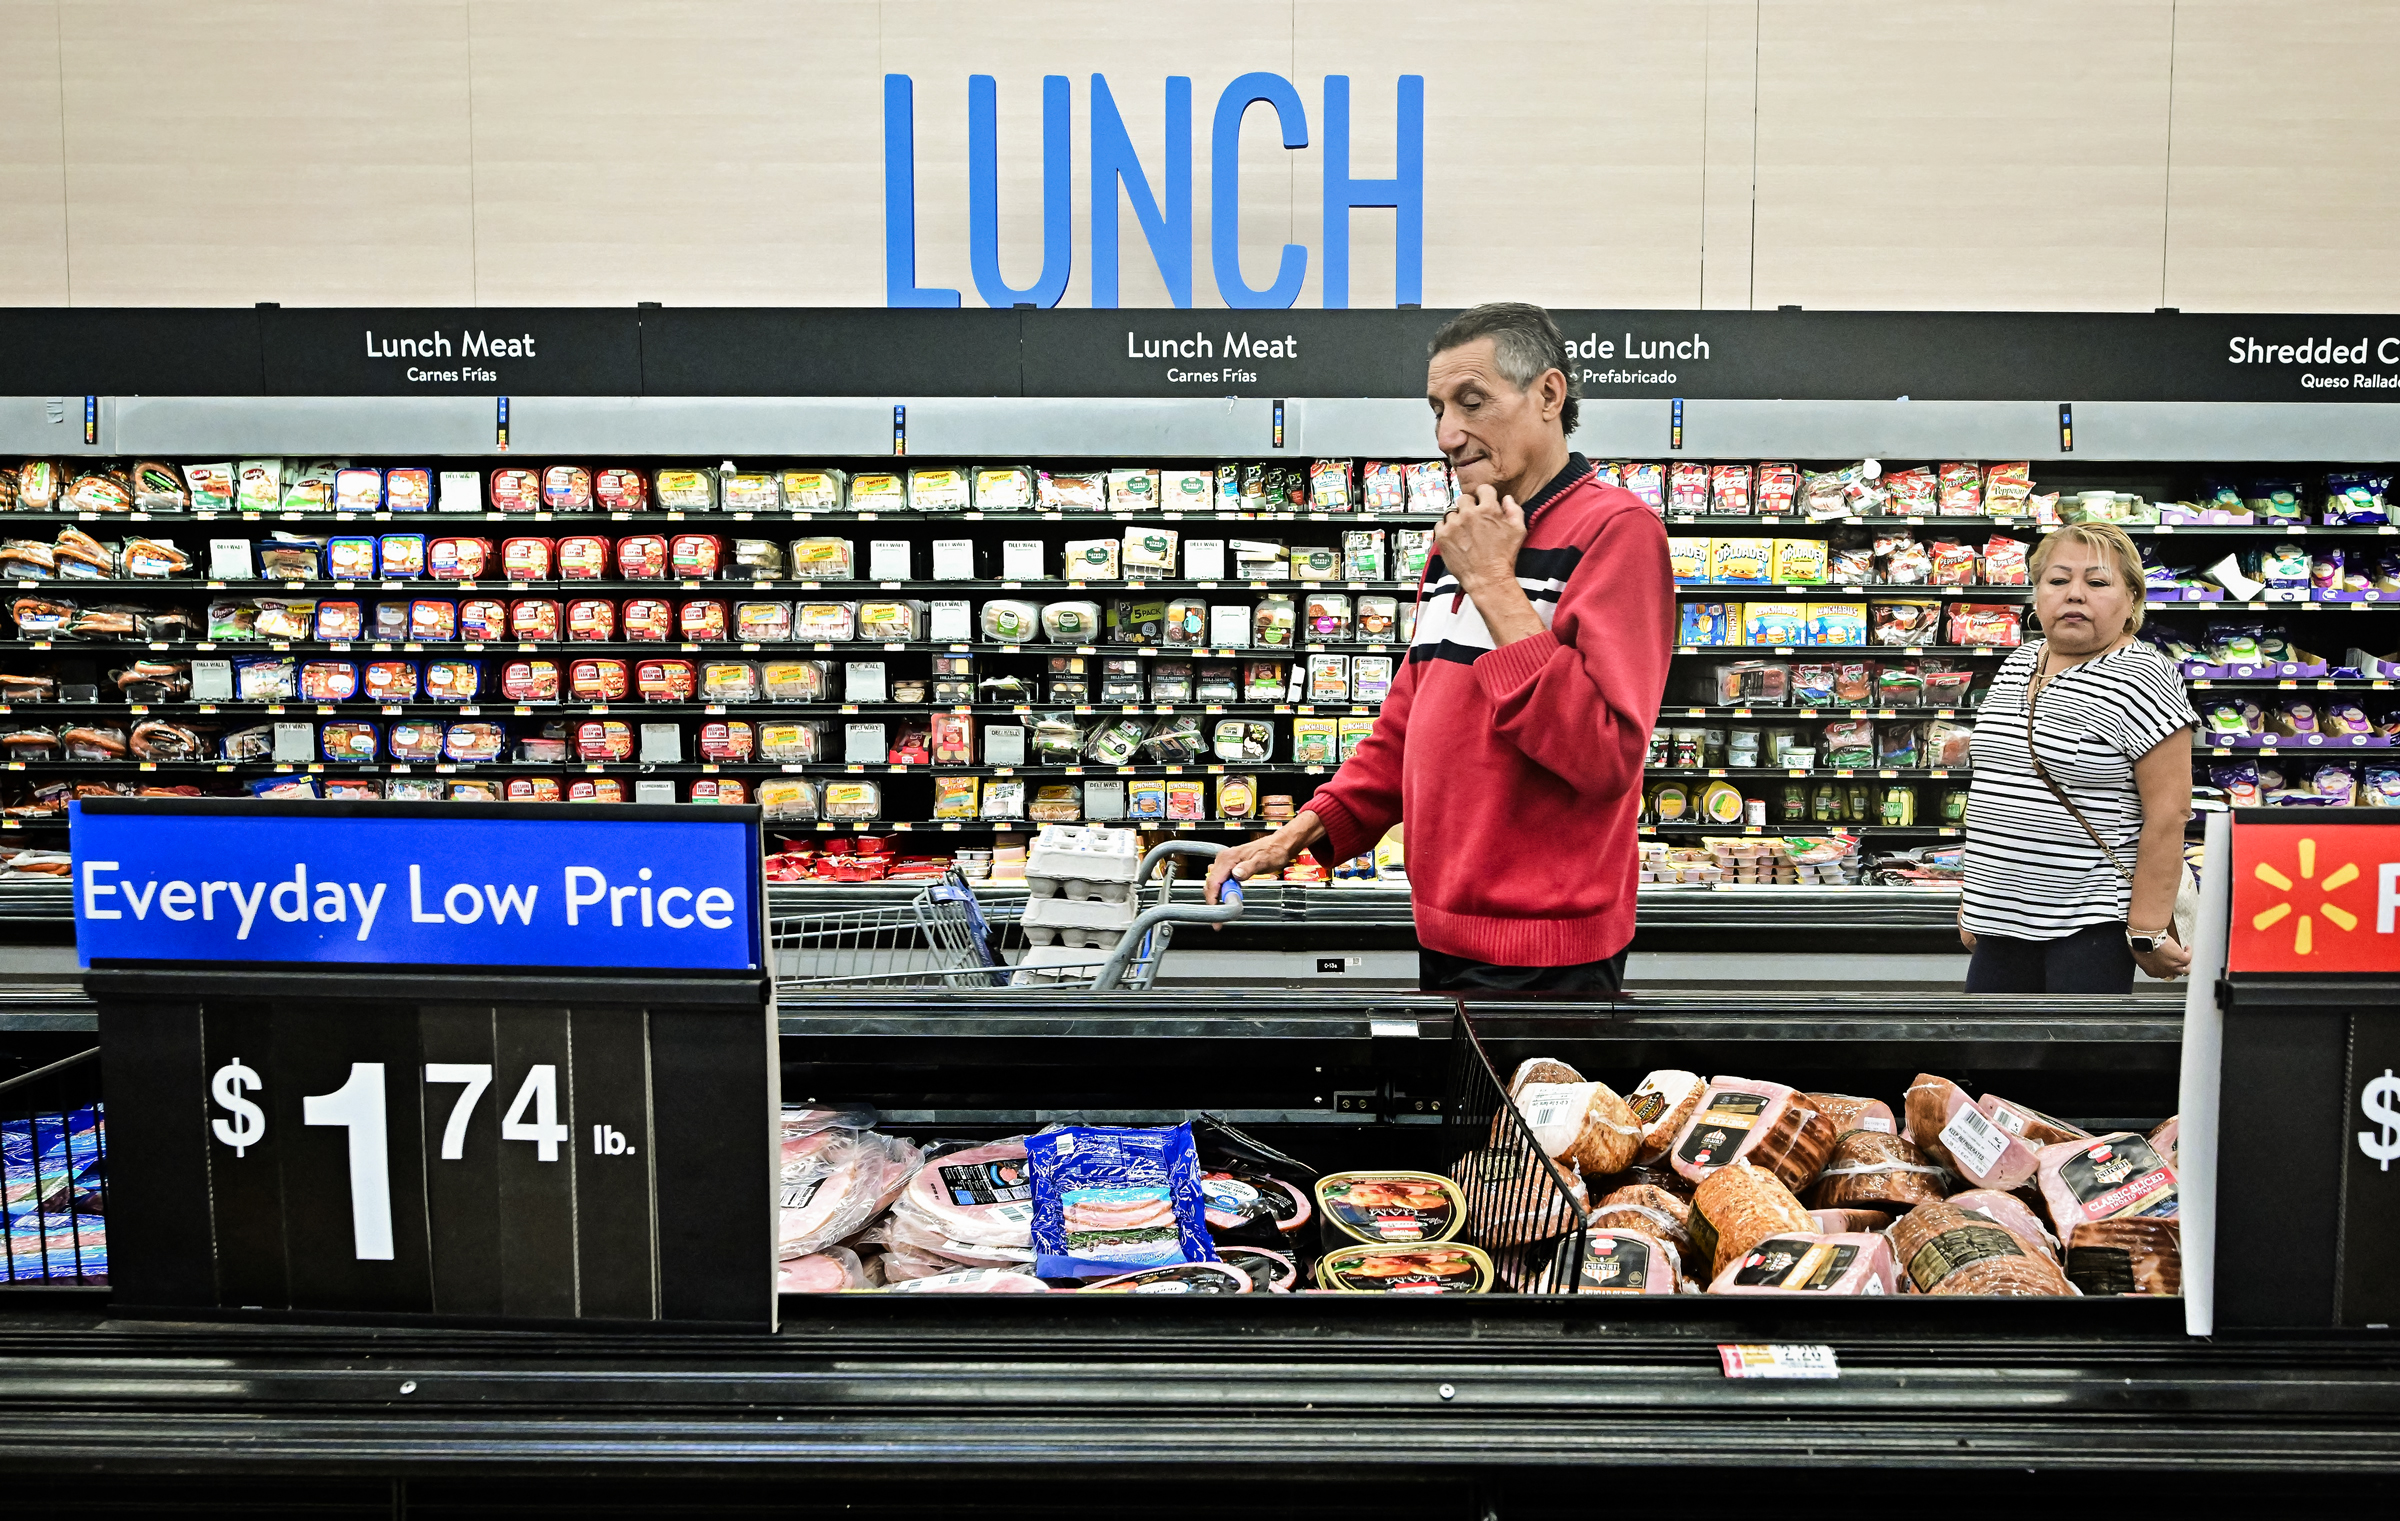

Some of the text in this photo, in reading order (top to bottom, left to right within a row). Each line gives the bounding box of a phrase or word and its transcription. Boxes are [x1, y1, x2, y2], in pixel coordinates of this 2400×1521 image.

[884, 71, 1424, 309] LUNCH
[366, 330, 536, 358] Lunch Meat
[1128, 331, 1298, 358] Lunch Meat
[1625, 333, 1710, 360] Lunch
[2228, 336, 2368, 365] Shredded
[407, 366, 497, 382] Carnes Frías
[1167, 368, 1257, 383] Carnes Frías
[1583, 369, 1677, 384] Prefabricado
[2300, 373, 2349, 389] Queso
[1222, 465, 1237, 478] P3
[1249, 466, 1262, 477] P3
[1268, 472, 1283, 484] P3
[1288, 474, 1302, 486] P3
[1946, 472, 1976, 488] PEPPERONI
[1120, 603, 1131, 612] P3
[1134, 608, 1162, 619] 5 PACK
[1298, 724, 1333, 733] LUNCHABLES
[83, 860, 735, 941] Everyday Low Price
[211, 1057, 266, 1158] $
[592, 1124, 637, 1157] lb.
[1959, 1136, 1985, 1161] REFRIGERATED
[2088, 1189, 2131, 1212] CLASSIC
[2130, 1172, 2166, 1196] SLICED
[2110, 1194, 2137, 1209] SMOKED
[2138, 1187, 2153, 1197] HAM
